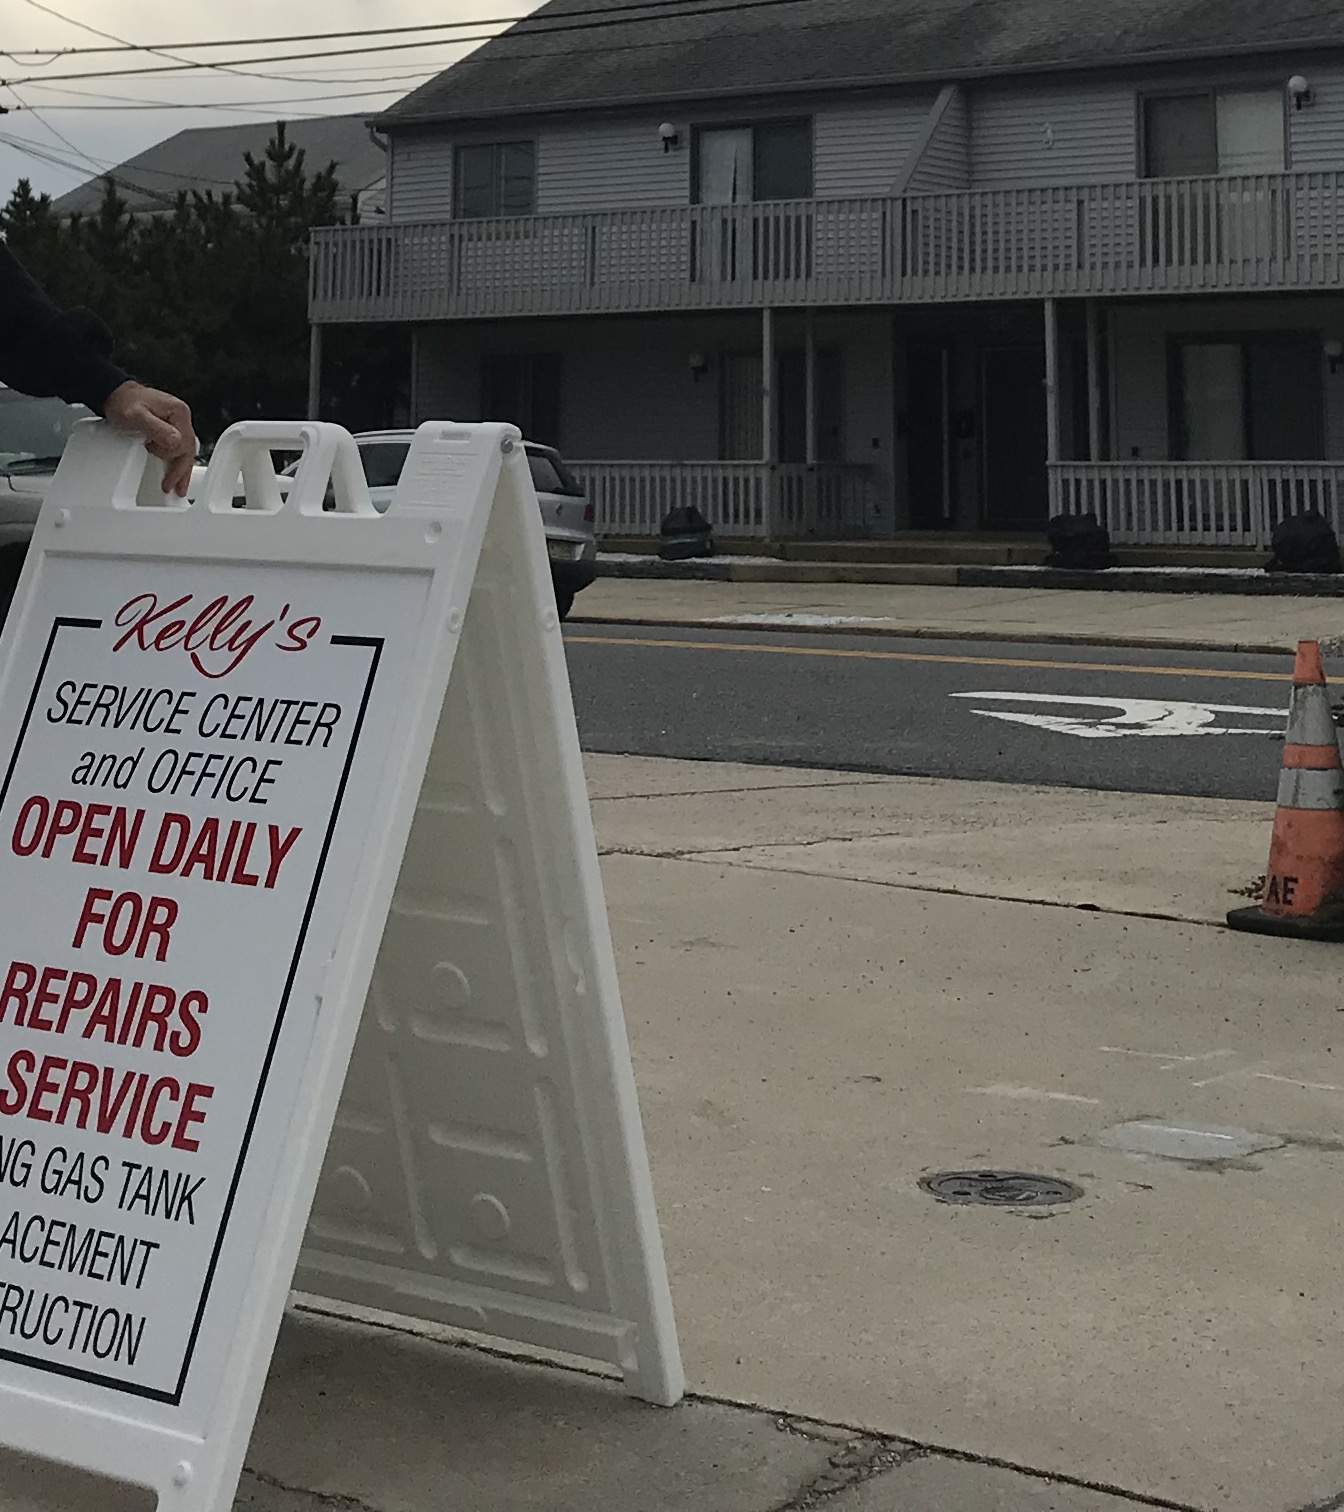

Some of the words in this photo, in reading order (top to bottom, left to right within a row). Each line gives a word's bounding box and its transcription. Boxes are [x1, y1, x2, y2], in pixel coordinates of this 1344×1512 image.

[112, 592, 323, 679] Kelly's
[46, 679, 196, 734] SERVICE
[197, 692, 342, 749] CENTER
[70, 747, 145, 790] and
[147, 748, 283, 804] OFFICE
[10, 794, 145, 869] OPEN
[147, 813, 304, 889] DAILY
[71, 888, 179, 963] FOR
[40, 1146, 112, 1203] GAS
[118, 1161, 207, 1226] TANK
